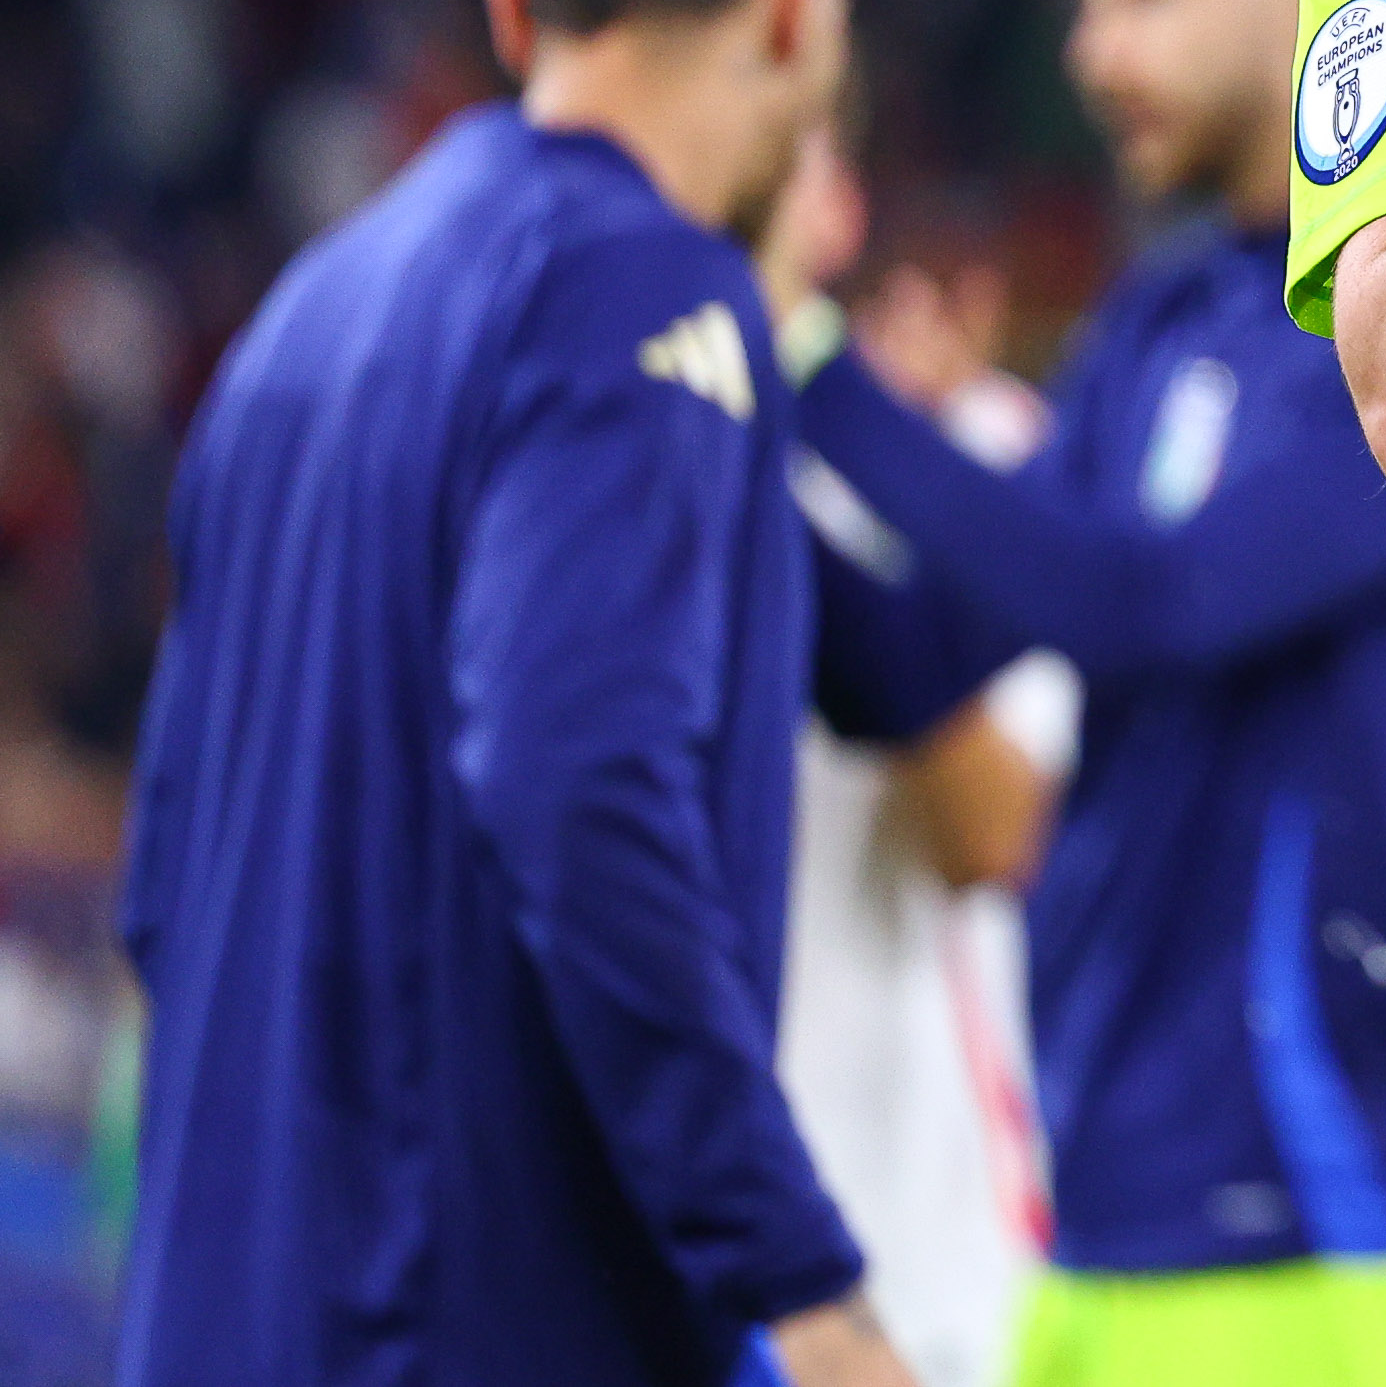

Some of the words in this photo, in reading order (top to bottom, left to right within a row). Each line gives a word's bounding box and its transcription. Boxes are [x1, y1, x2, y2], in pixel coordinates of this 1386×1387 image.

[1331, 11, 1366, 37] UEFA
[1317, 22, 1385, 71] EUROPEAN
[1317, 39, 1383, 87] CHAMPIONS
[1333, 155, 1359, 182] 2020
